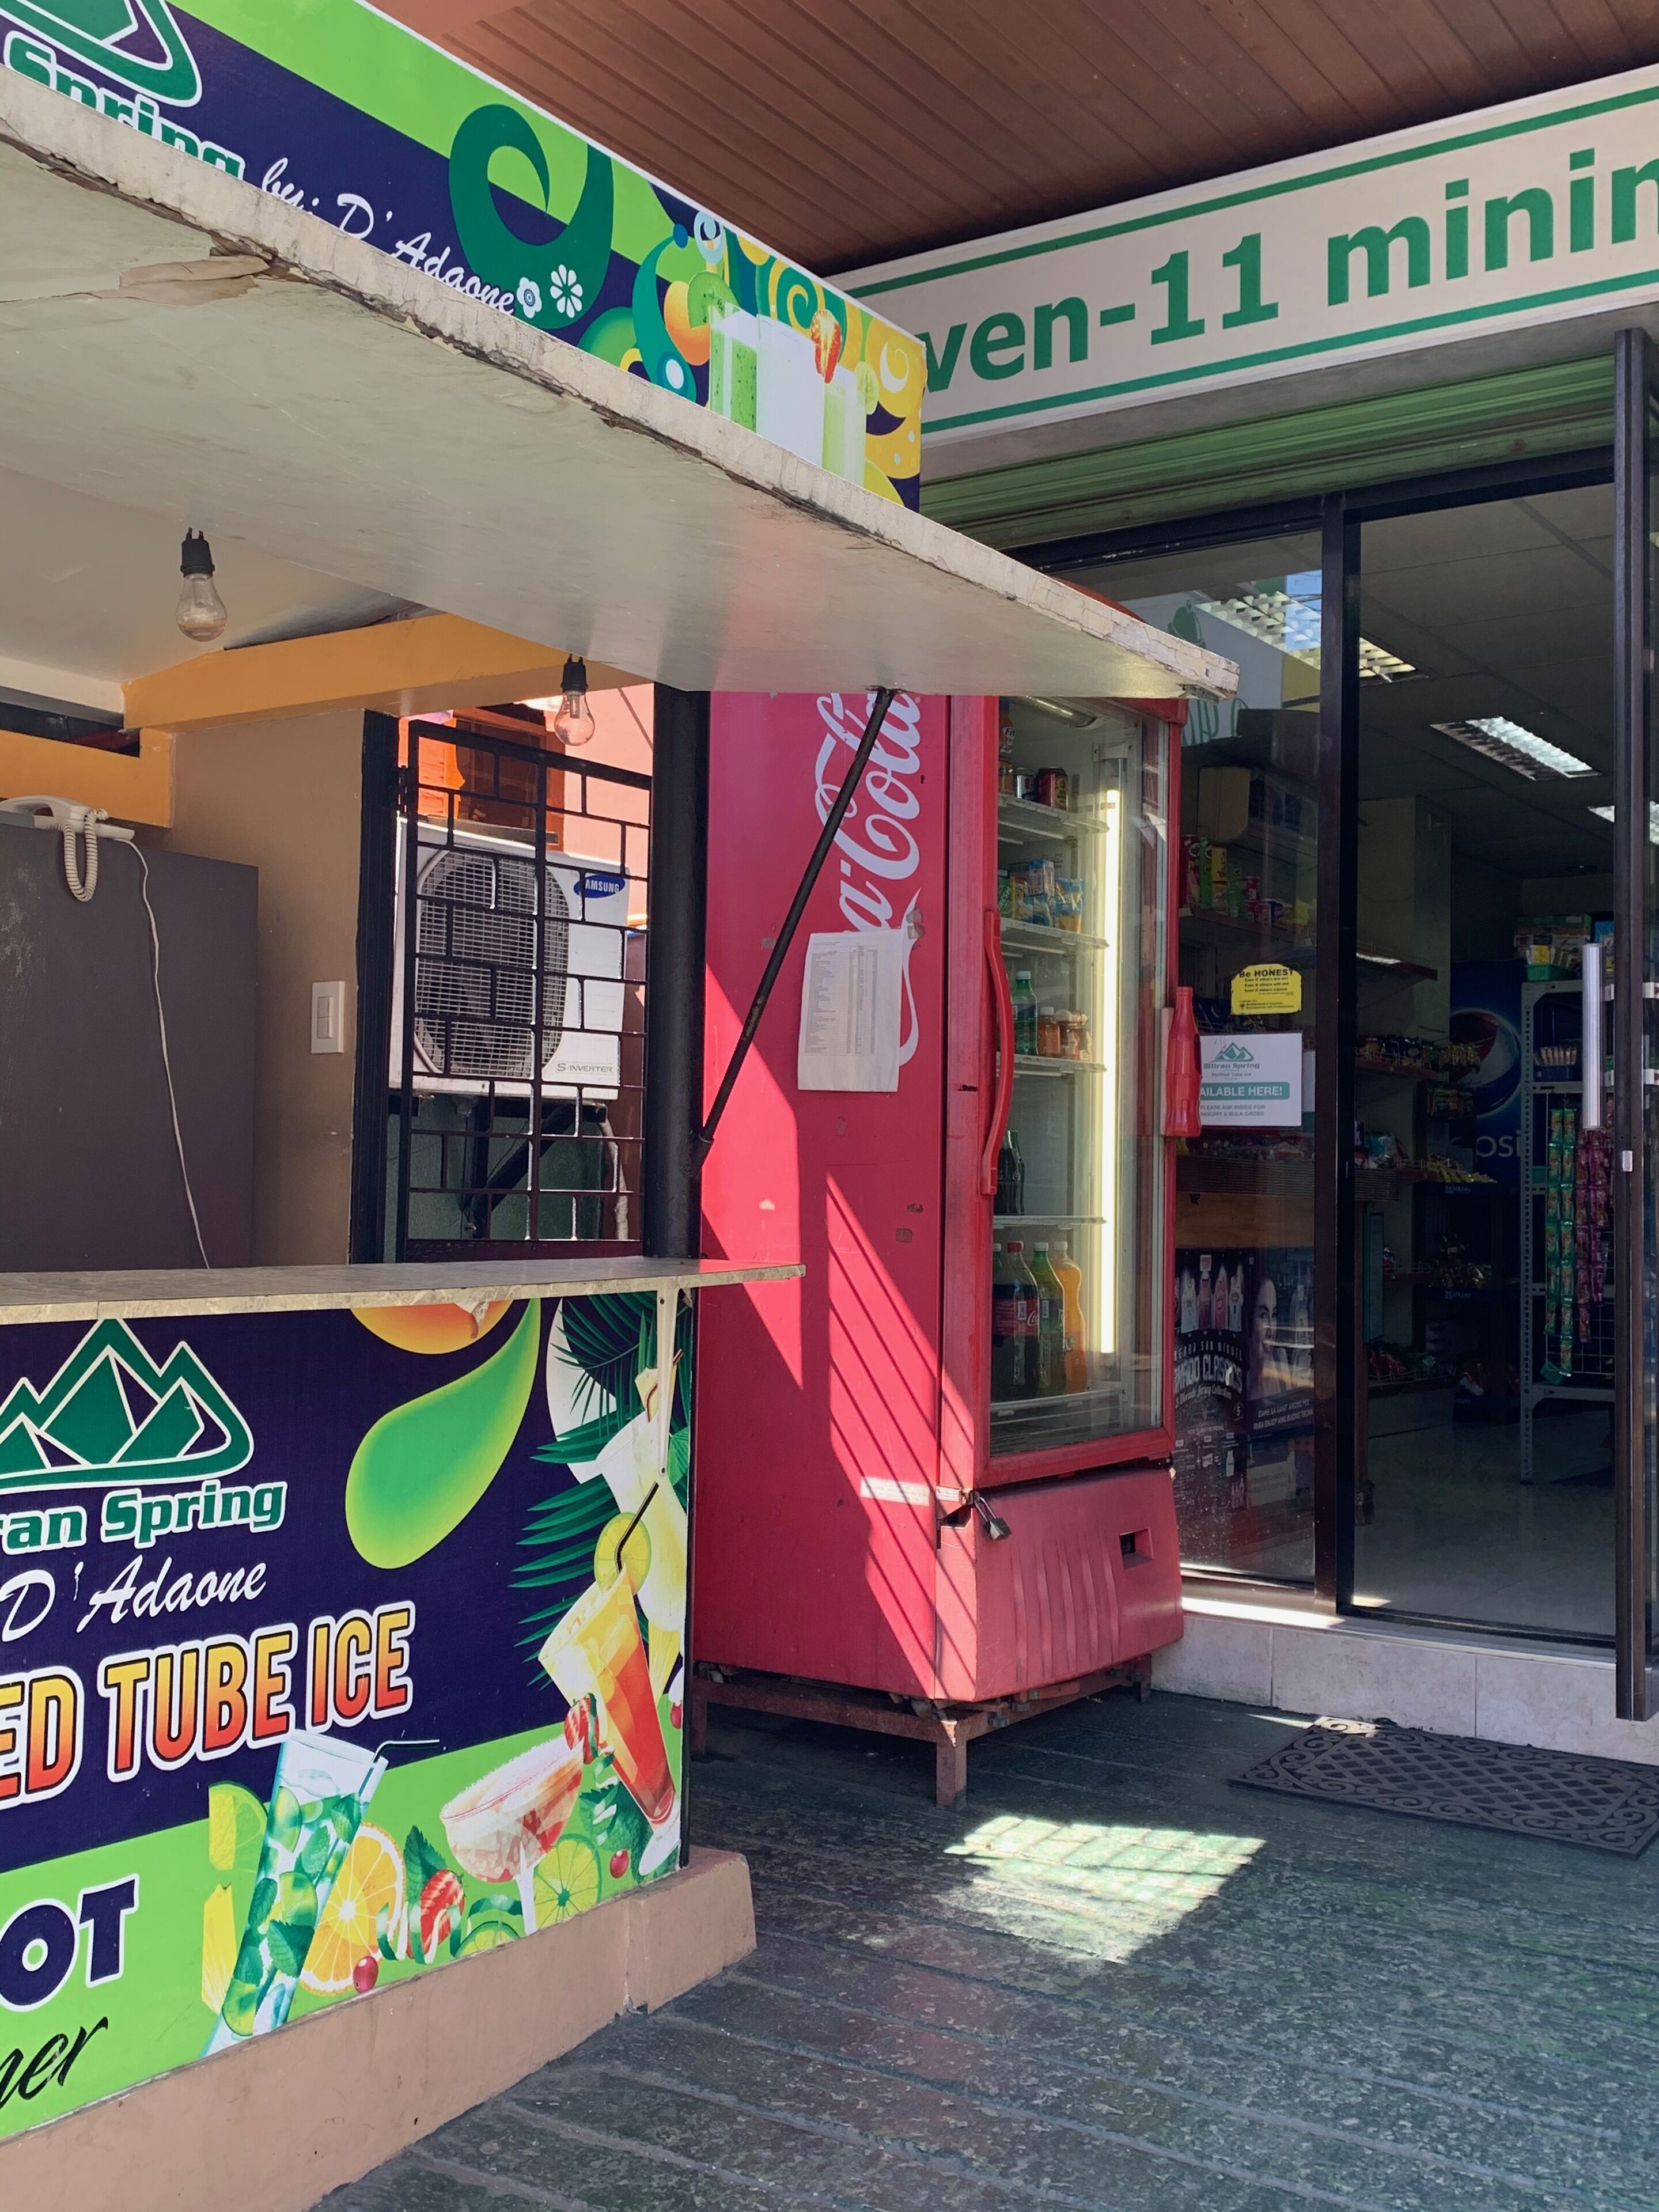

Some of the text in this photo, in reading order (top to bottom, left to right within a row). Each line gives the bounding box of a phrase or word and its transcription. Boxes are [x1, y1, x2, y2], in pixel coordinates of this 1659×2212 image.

[816, 692, 921, 934] a-Cola
[586, 879, 619, 893] AMSUNG
[1255, 969, 1293, 977] HONEST
[1200, 1086, 1282, 1096] AILABLE HERE!
[0, 1480, 287, 1554] an Spring
[100, 1623, 296, 1781] TUBE
[307, 1601, 414, 1731] ICE
[0, 1874, 138, 2012] OT
